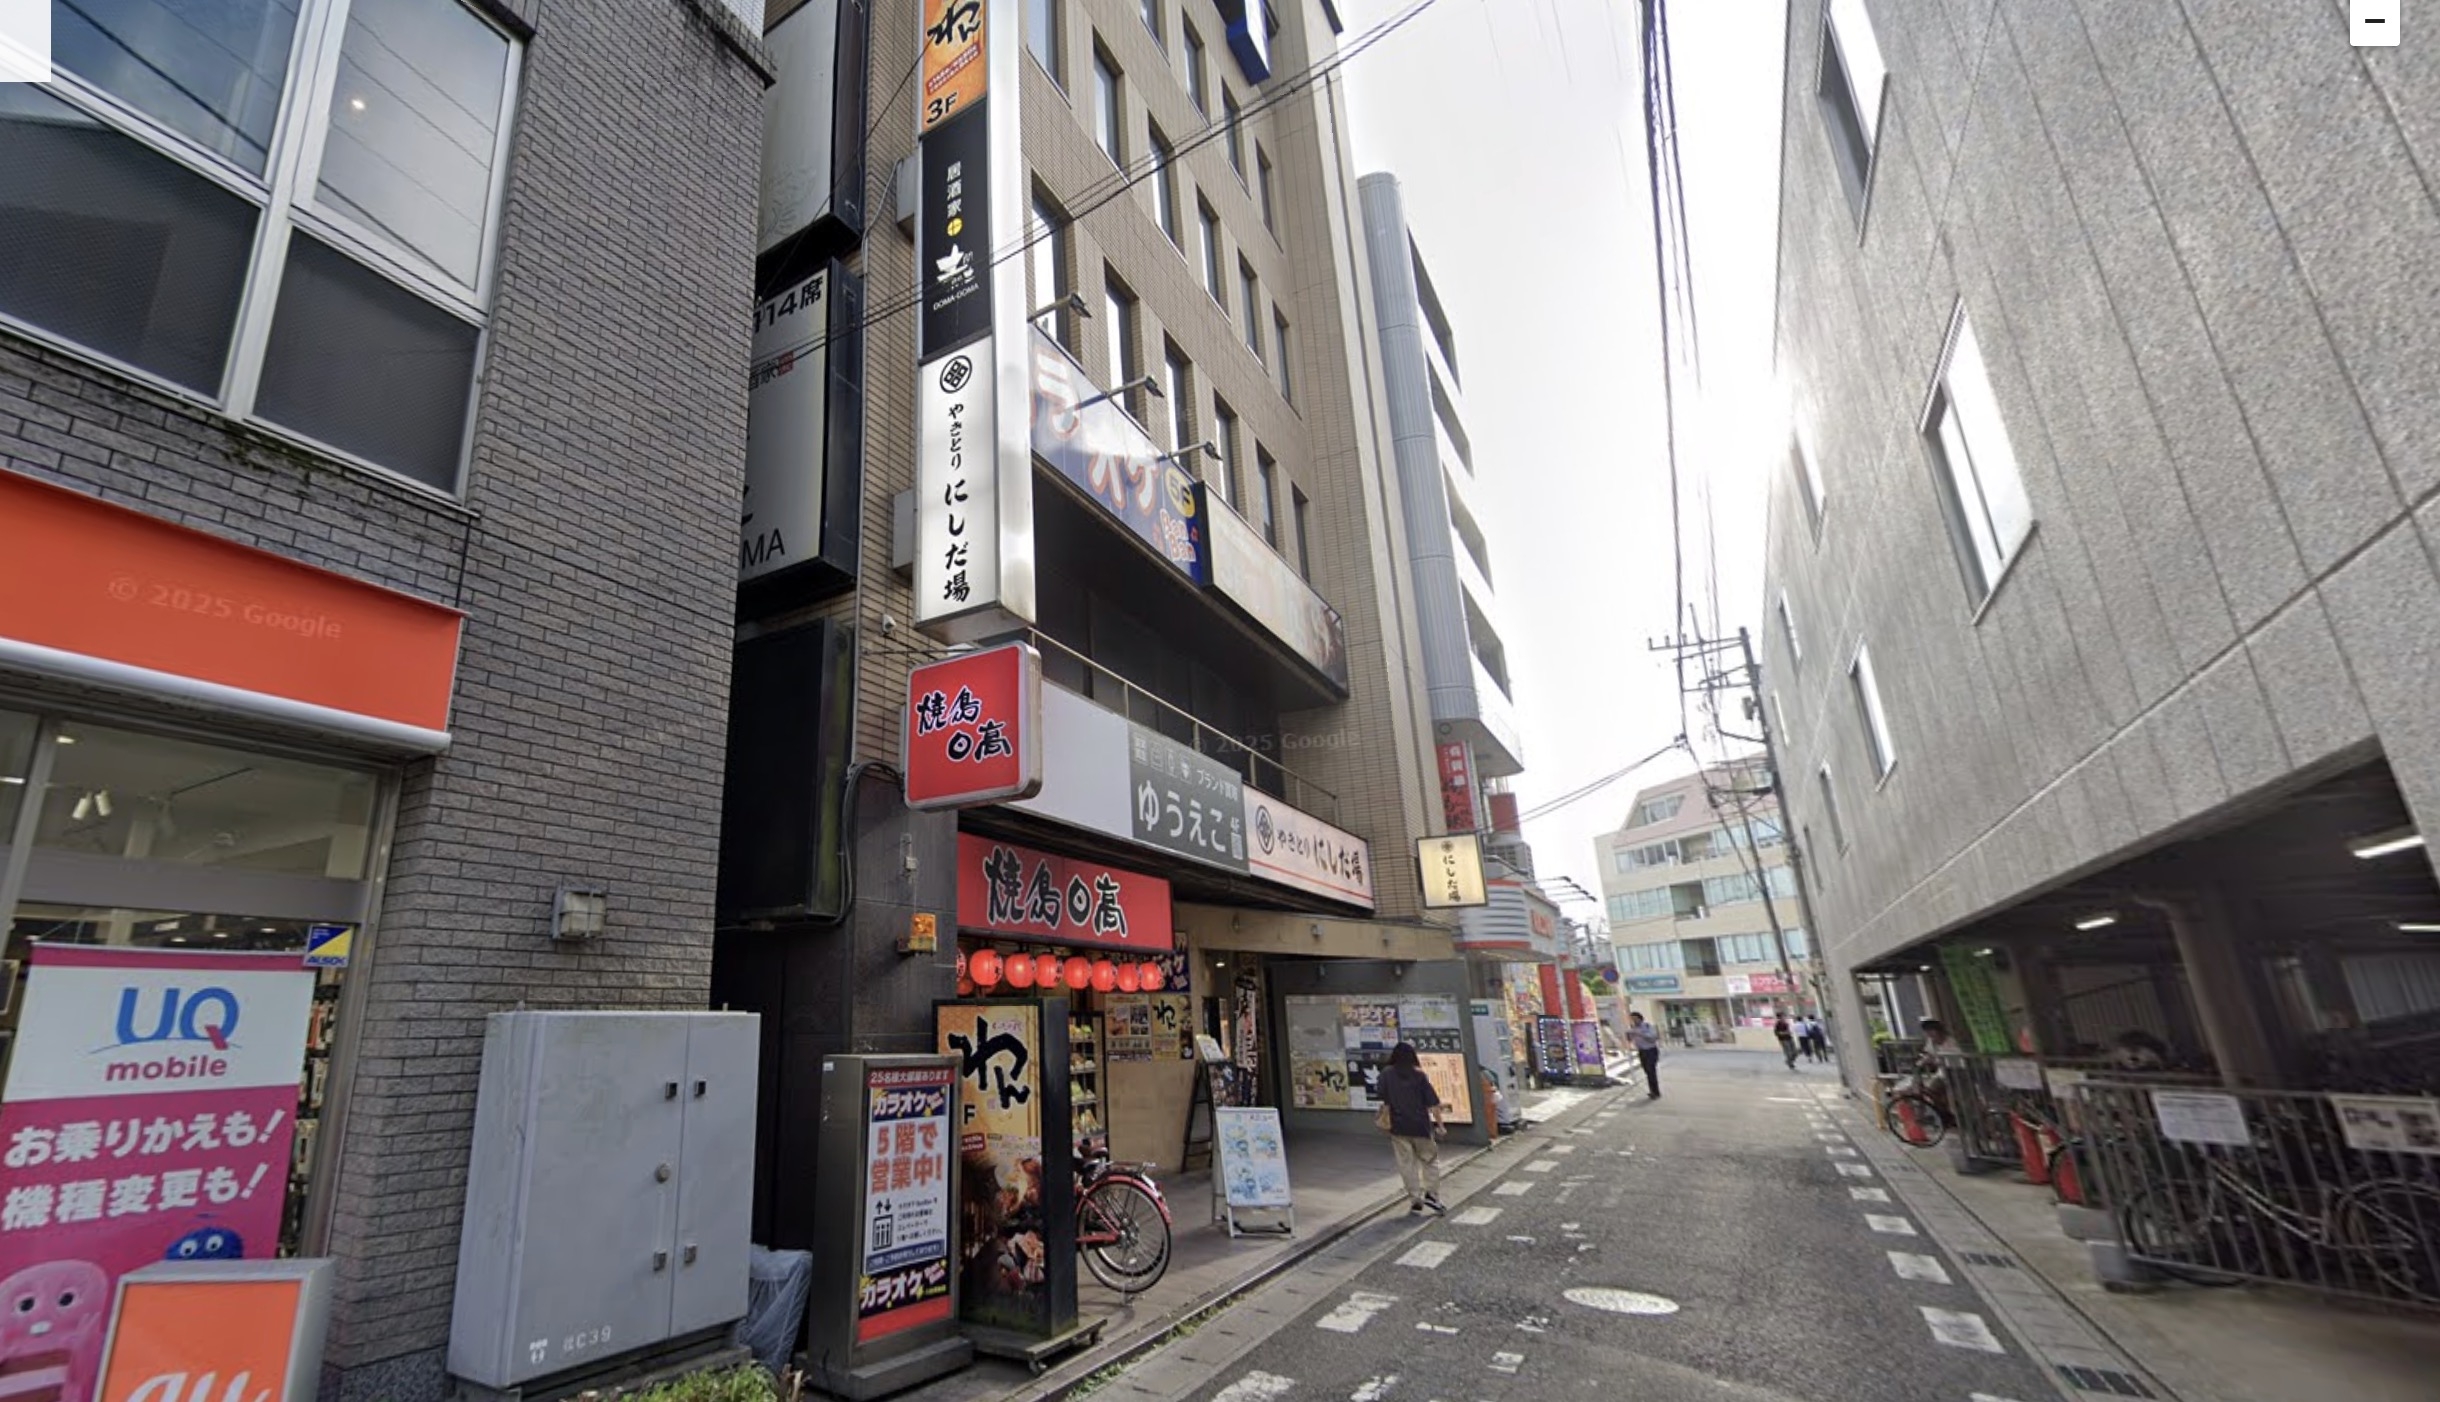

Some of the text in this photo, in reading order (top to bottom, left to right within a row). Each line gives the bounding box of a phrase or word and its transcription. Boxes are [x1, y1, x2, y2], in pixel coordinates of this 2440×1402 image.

[926, 1, 981, 46] わん
[926, 91, 958, 124] 3F
[943, 402, 971, 602] やきとり にしだ場
[916, 685, 982, 736] 焼鳥
[1138, 780, 1226, 852] ゆうえこ
[117, 987, 240, 1050] UQ
[106, 1055, 228, 1082] mobile
[947, 1015, 1030, 1109] わん
[873, 1091, 926, 1116] カラオケ
[4, 1109, 285, 1167] お乗りかえも!
[877, 1121, 938, 1156] 5階で
[1, 1163, 270, 1231] 機種変更も!
[871, 1153, 943, 1193] 営業中!
[860, 1271, 923, 1310] カラオケ
